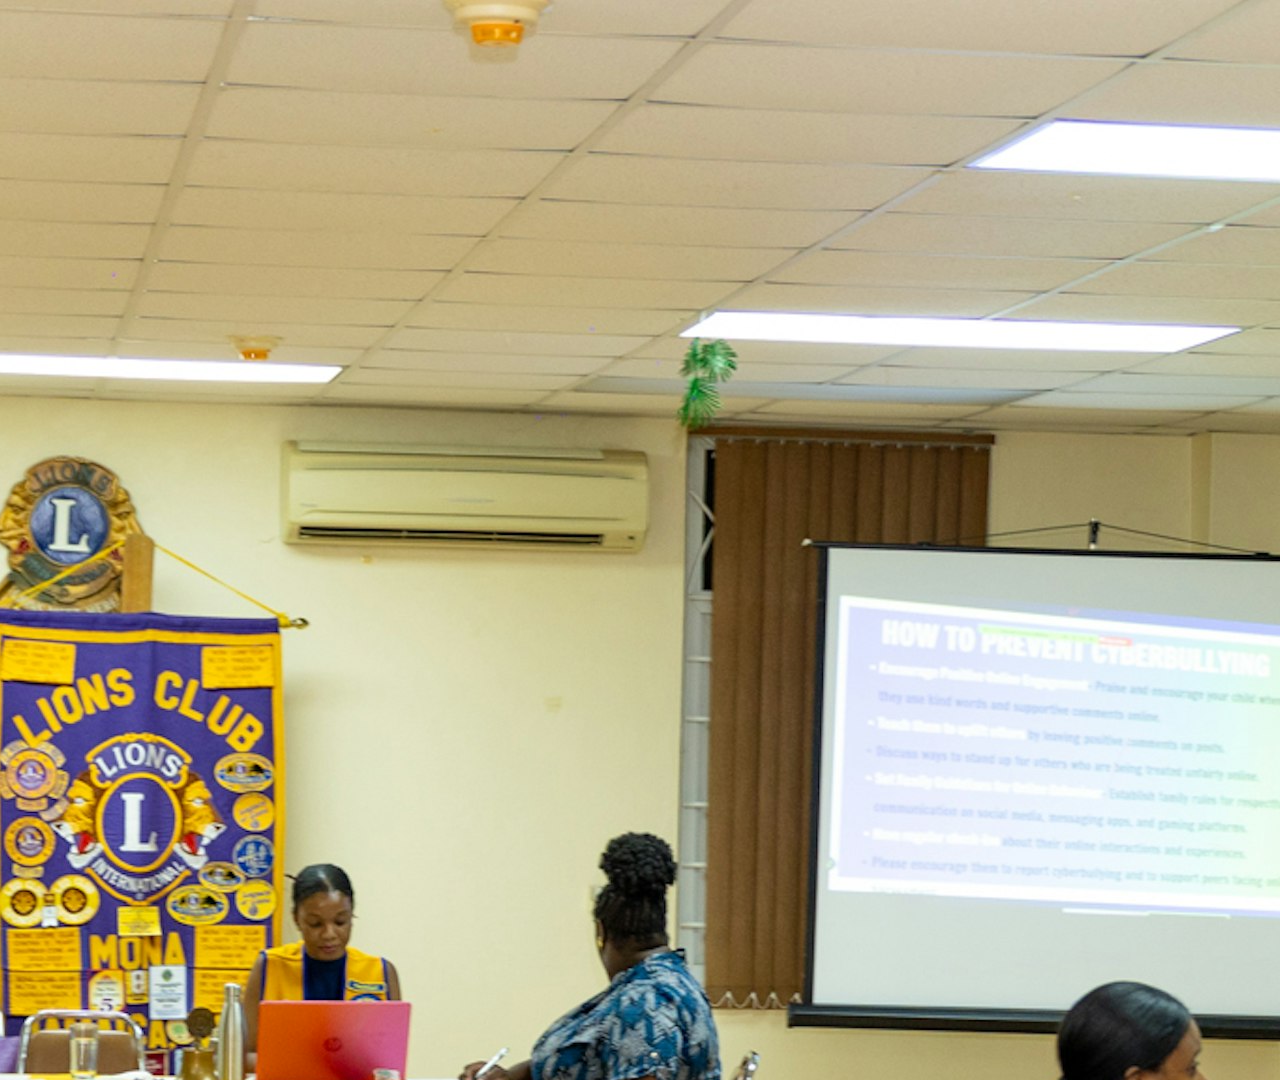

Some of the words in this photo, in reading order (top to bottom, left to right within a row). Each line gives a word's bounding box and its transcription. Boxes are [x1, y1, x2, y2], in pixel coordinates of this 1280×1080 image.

[48, 498, 91, 553] L
[881, 619, 941, 650] HOW
[944, 624, 976, 652] TO
[12, 668, 136, 748] LIONS
[154, 670, 264, 752] CLUB
[95, 743, 184, 778] LIONS
[119, 792, 158, 852] L
[89, 932, 187, 971] MONA
